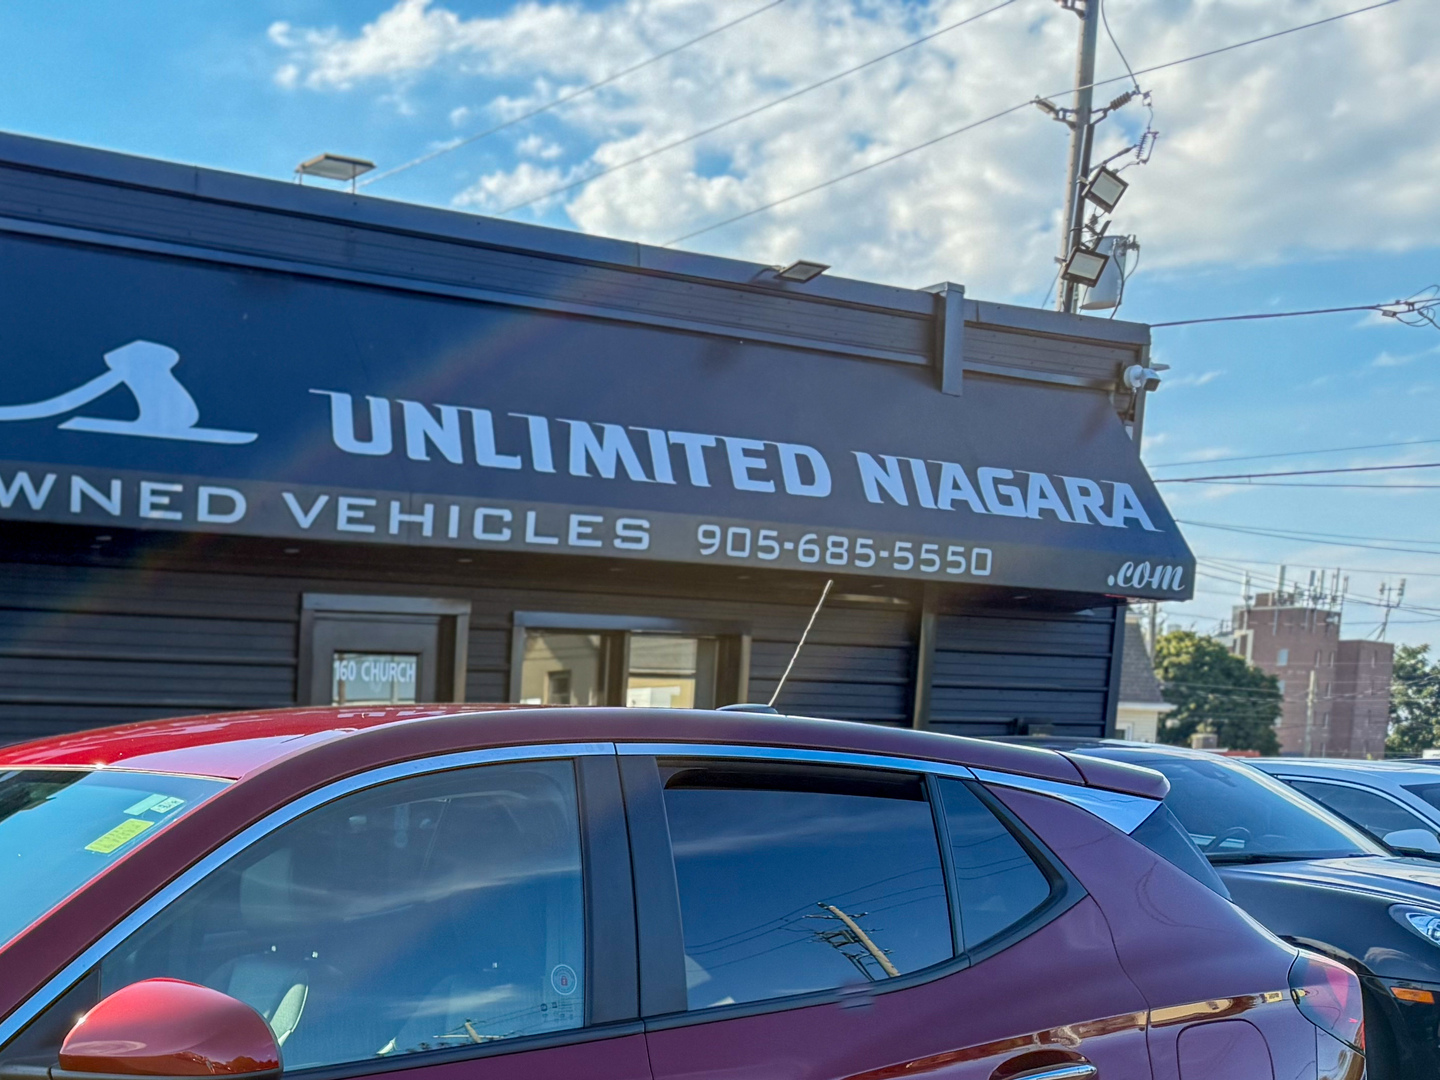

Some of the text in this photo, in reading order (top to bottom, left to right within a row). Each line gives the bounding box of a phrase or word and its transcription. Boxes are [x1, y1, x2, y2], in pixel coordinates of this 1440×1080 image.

[309, 389, 1162, 532] UNLIMITED NIAGARA
[281, 492, 651, 551] VEHICLES
[696, 523, 993, 576] 905-685-5550
[1107, 561, 1185, 591] .com
[334, 660, 415, 682] 160 CHURCH
